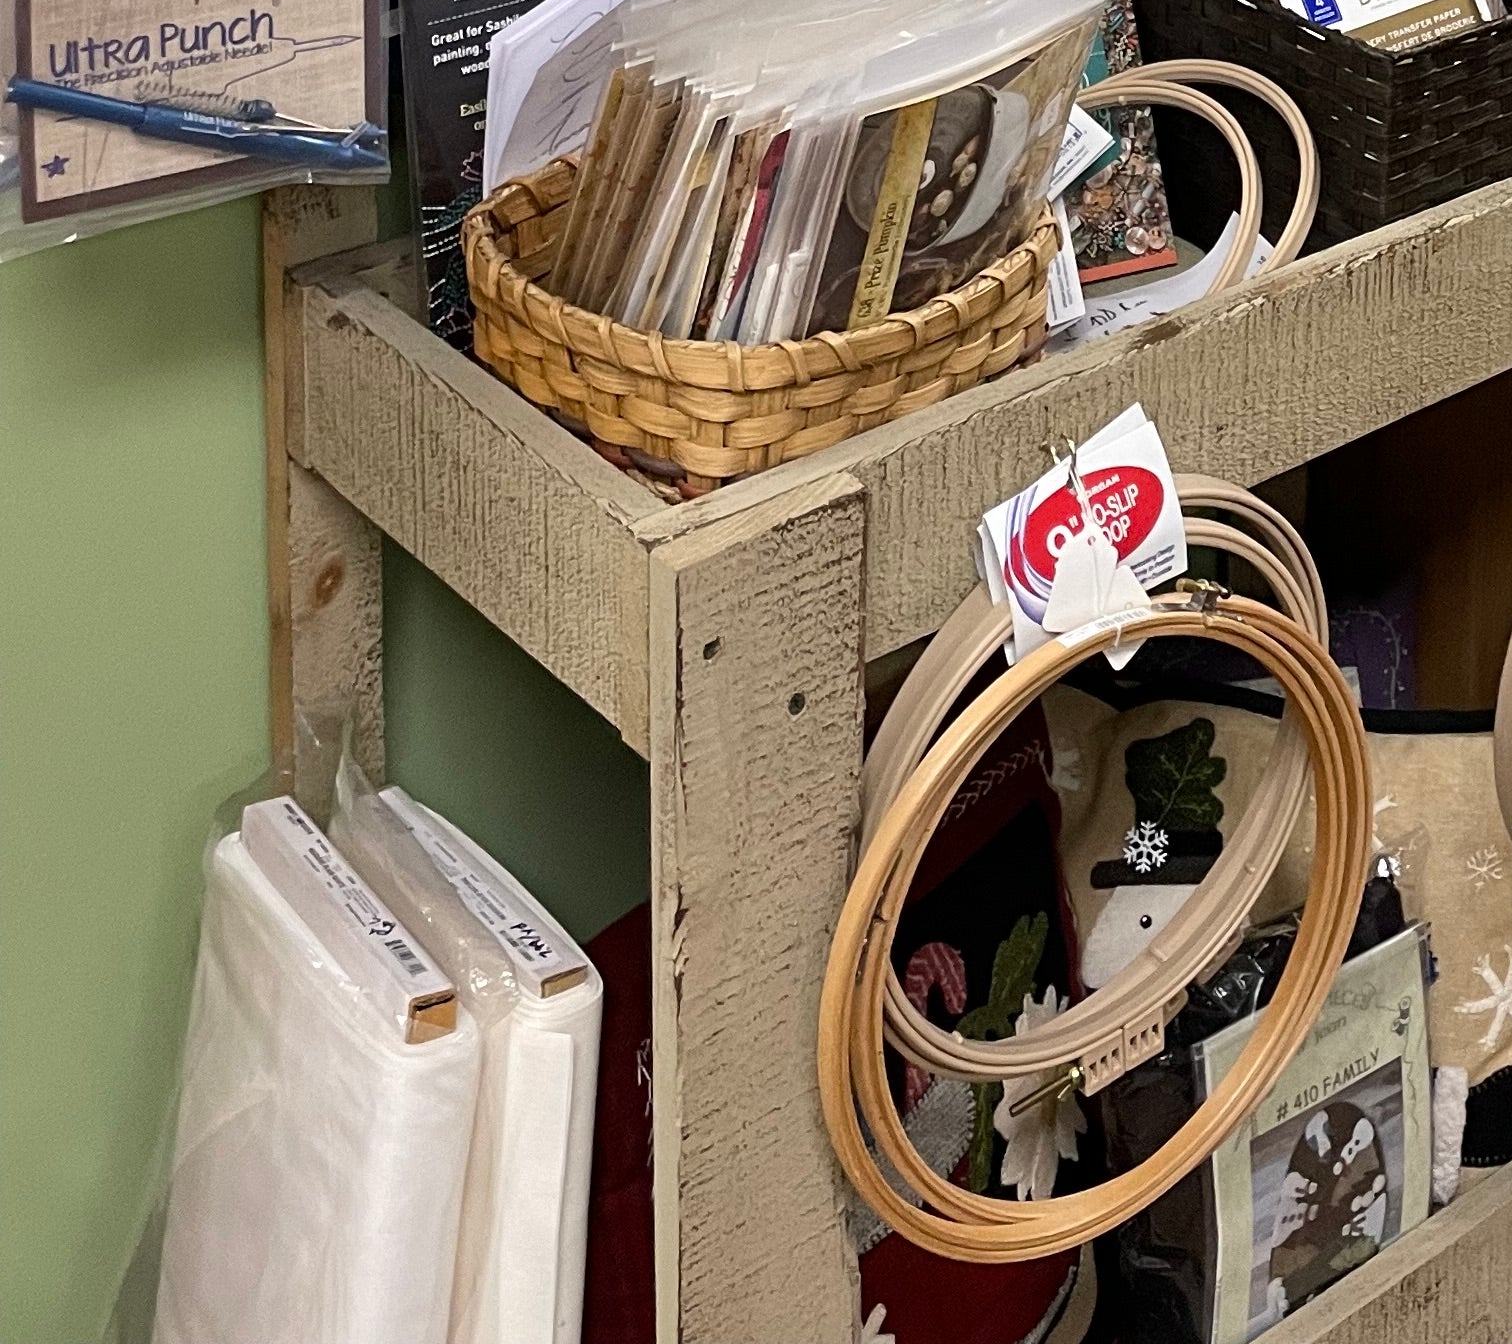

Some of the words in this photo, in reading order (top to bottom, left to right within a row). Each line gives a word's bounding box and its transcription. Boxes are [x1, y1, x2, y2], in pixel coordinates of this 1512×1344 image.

[160, 9, 273, 58] Punch
[466, 24, 483, 38] for
[485, 14, 522, 34] Sashi
[1388, 18, 1432, 40] TRANSFER
[1434, 7, 1462, 24] PAPER
[1421, 32, 1434, 43] DE
[1435, 15, 1477, 39] BRODERIE
[459, 100, 487, 117] Easil
[1089, 484, 1139, 527] O-SLIP
[1276, 1101, 1289, 1122] #
[1293, 1085, 1319, 1109] 410
[1322, 1047, 1380, 1096] FAMILY
